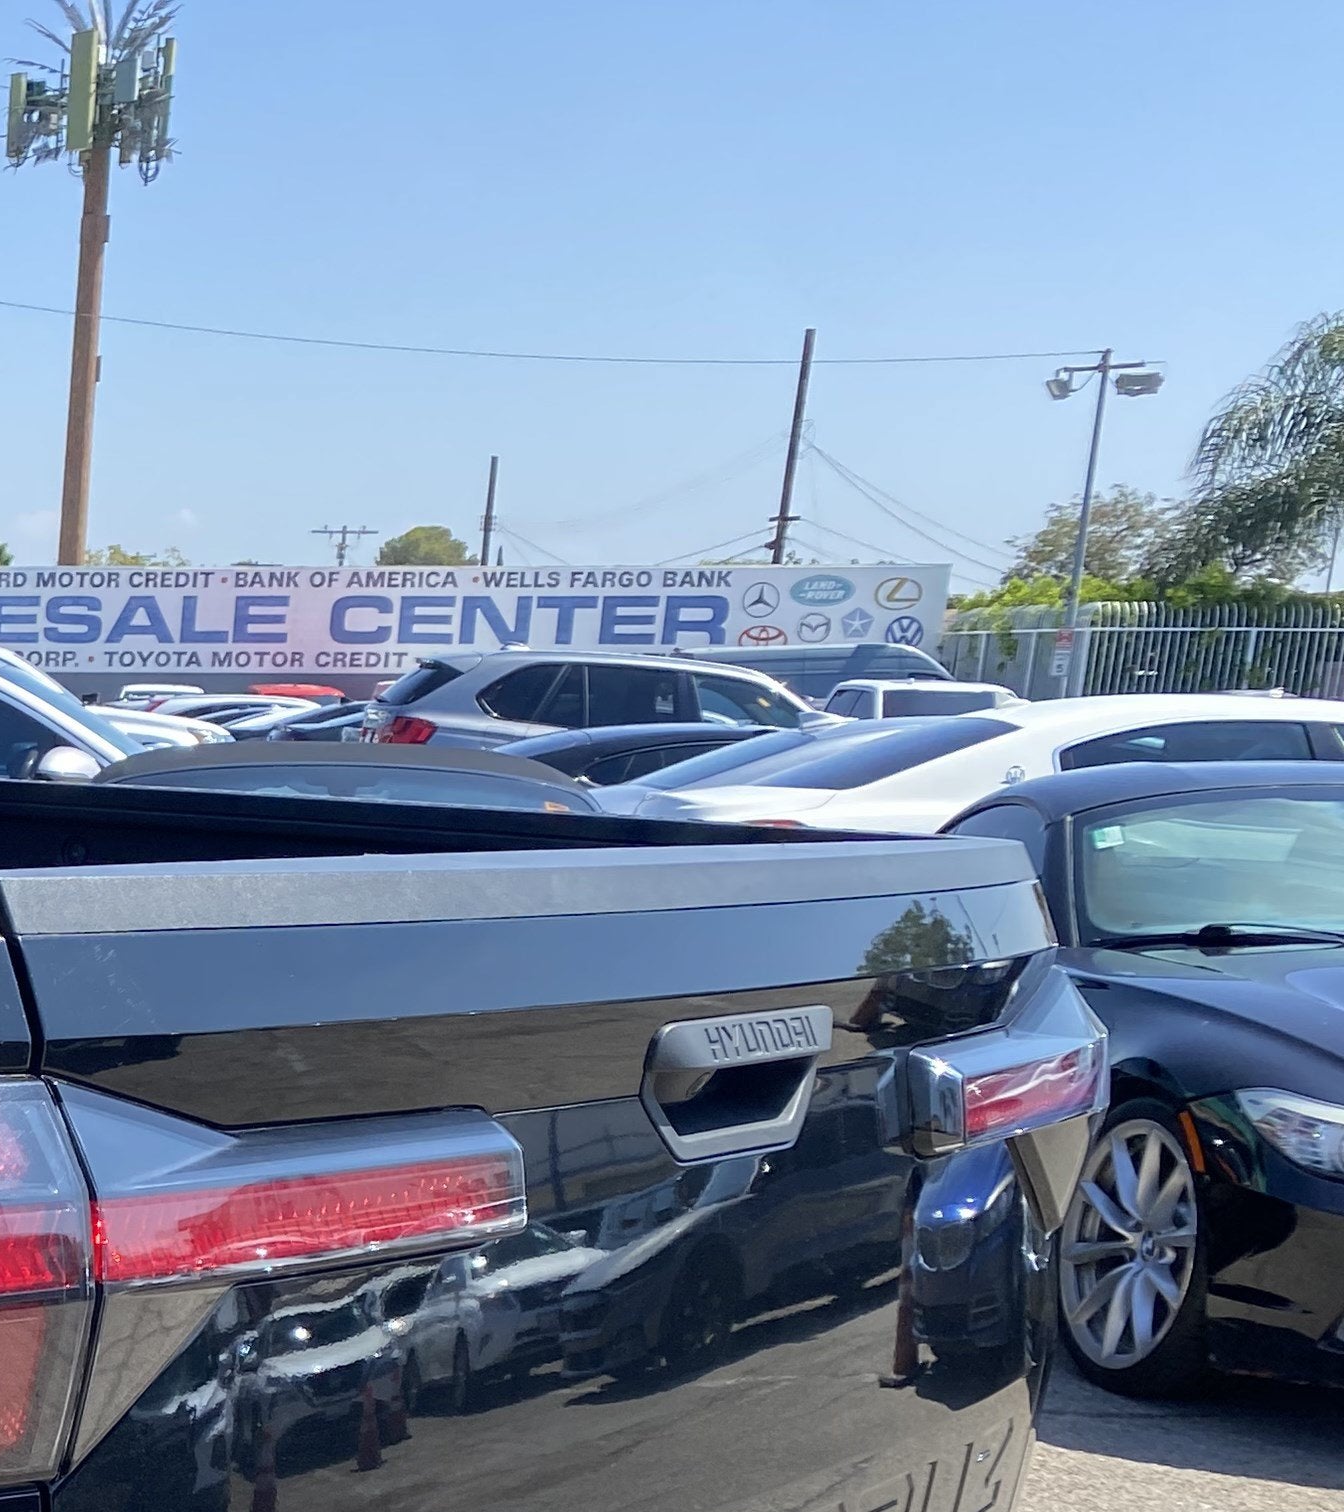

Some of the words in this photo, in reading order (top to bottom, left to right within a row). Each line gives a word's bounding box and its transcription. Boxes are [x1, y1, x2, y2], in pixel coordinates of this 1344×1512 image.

[35, 571, 121, 589] MOTOR
[128, 571, 215, 589] CREDIT
[233, 571, 300, 589] BANK
[309, 571, 340, 589] OF
[345, 571, 459, 589] AMERICA
[482, 570, 561, 589] WELLS
[569, 570, 653, 589] FARGO
[662, 570, 733, 589] BANK
[328, 595, 731, 645] CENTER
[14, 650, 80, 668] ORP.
[103, 650, 202, 668] TOYOTA
[211, 650, 305, 669] MOTOR
[314, 650, 409, 669] CREDIT
[703, 1015, 820, 1063] HYUNDAI
